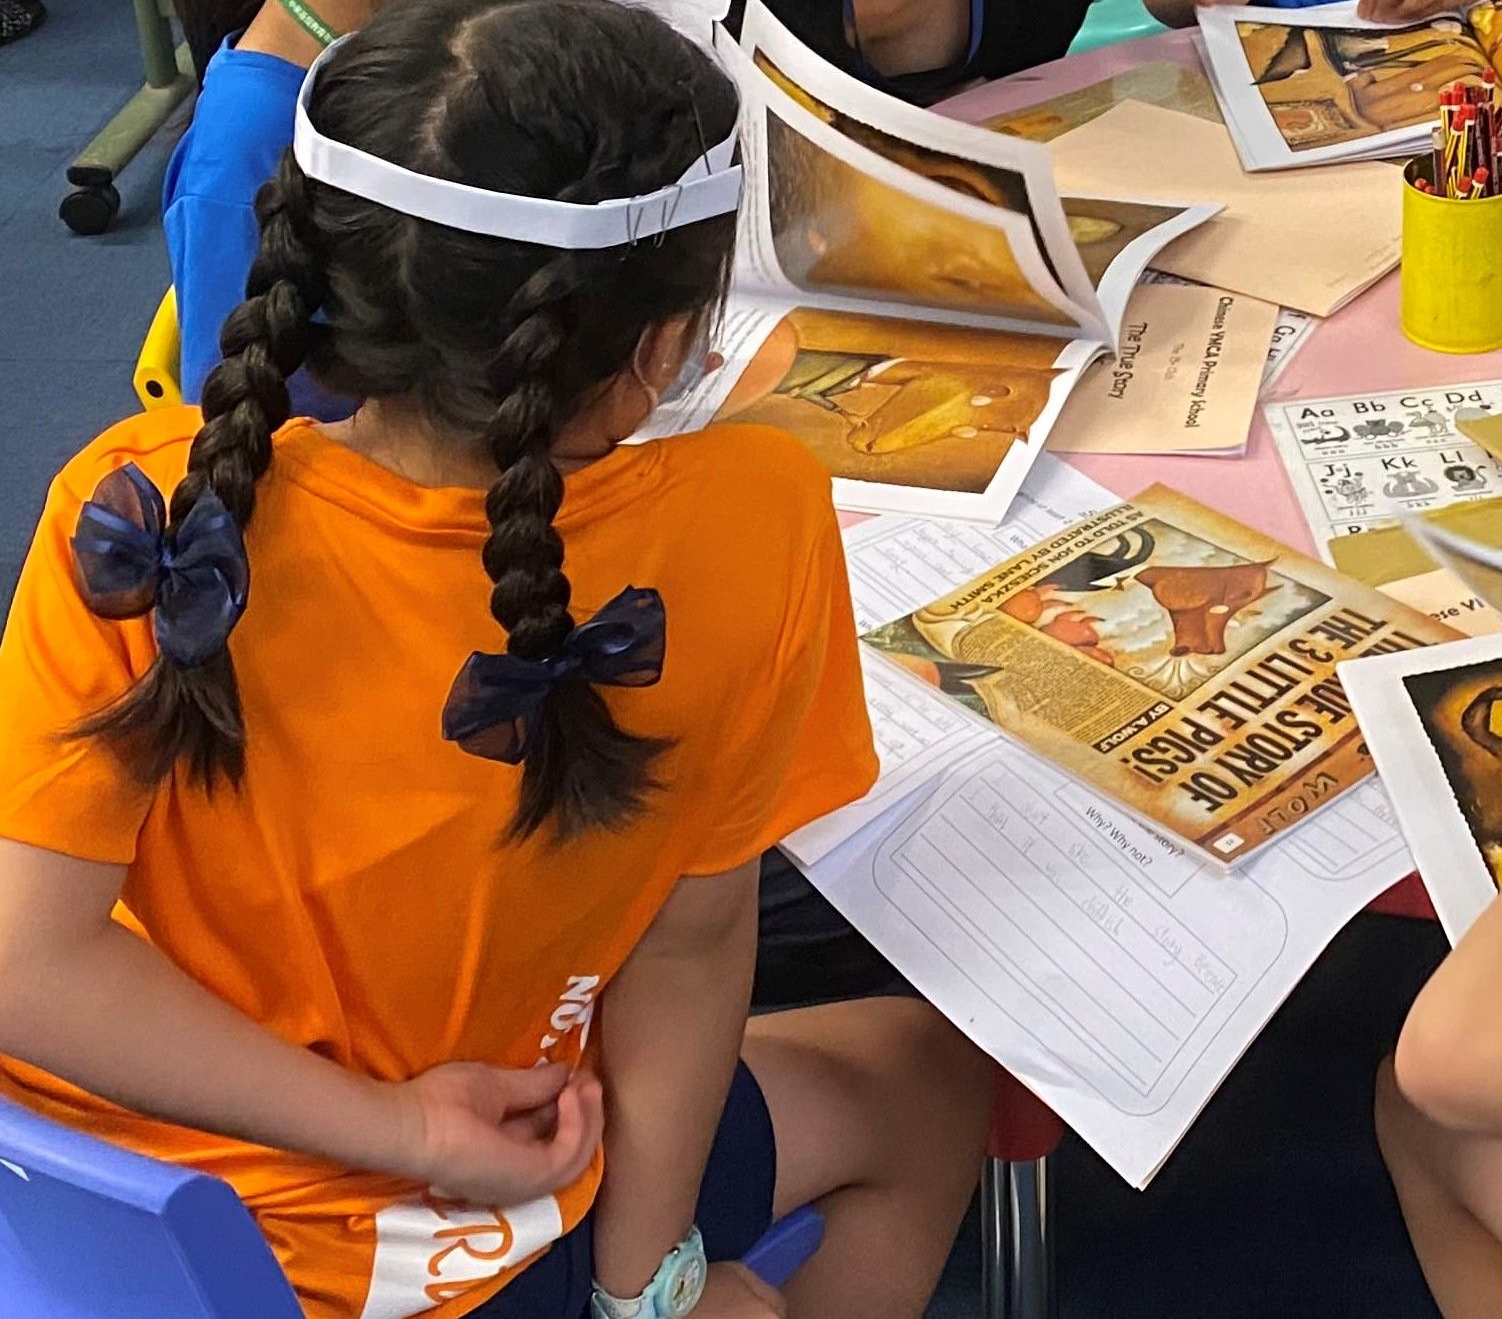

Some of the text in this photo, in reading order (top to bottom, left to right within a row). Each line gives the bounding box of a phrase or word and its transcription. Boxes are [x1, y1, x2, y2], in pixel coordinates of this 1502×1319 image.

[1211, 296, 1234, 330] Chinese
[1108, 322, 1148, 400] The True Story
[1190, 361, 1218, 404] Primary
[1301, 408, 1335, 420] Aa
[1352, 401, 1387, 414] Bb
[1400, 396, 1434, 408] Cc
[1444, 390, 1482, 404] Dd
[1381, 456, 1418, 471] Kk
[1440, 450, 1464, 464] Ll
[1075, 538, 1095, 548] TO
[1093, 521, 1127, 539] TOLD
[993, 558, 1031, 581] LANE
[1031, 549, 1052, 561] BY
[1049, 547, 1075, 564] JON
[949, 582, 996, 610] SMITH
[981, 563, 1050, 604] SCIESZKA
[1308, 608, 1388, 651] THE
[1288, 639, 1334, 664] 3
[1197, 652, 1314, 730] LITTLE
[1148, 703, 1170, 720] BY
[1120, 717, 1226, 783] PIGS!
[1205, 709, 1324, 788] STORY
[1178, 771, 1239, 813] OF
[1259, 771, 1340, 836] WOLF
[1085, 806, 1113, 831] Why?
[1110, 828, 1130, 850] Why
[1128, 845, 1154, 867] not?
